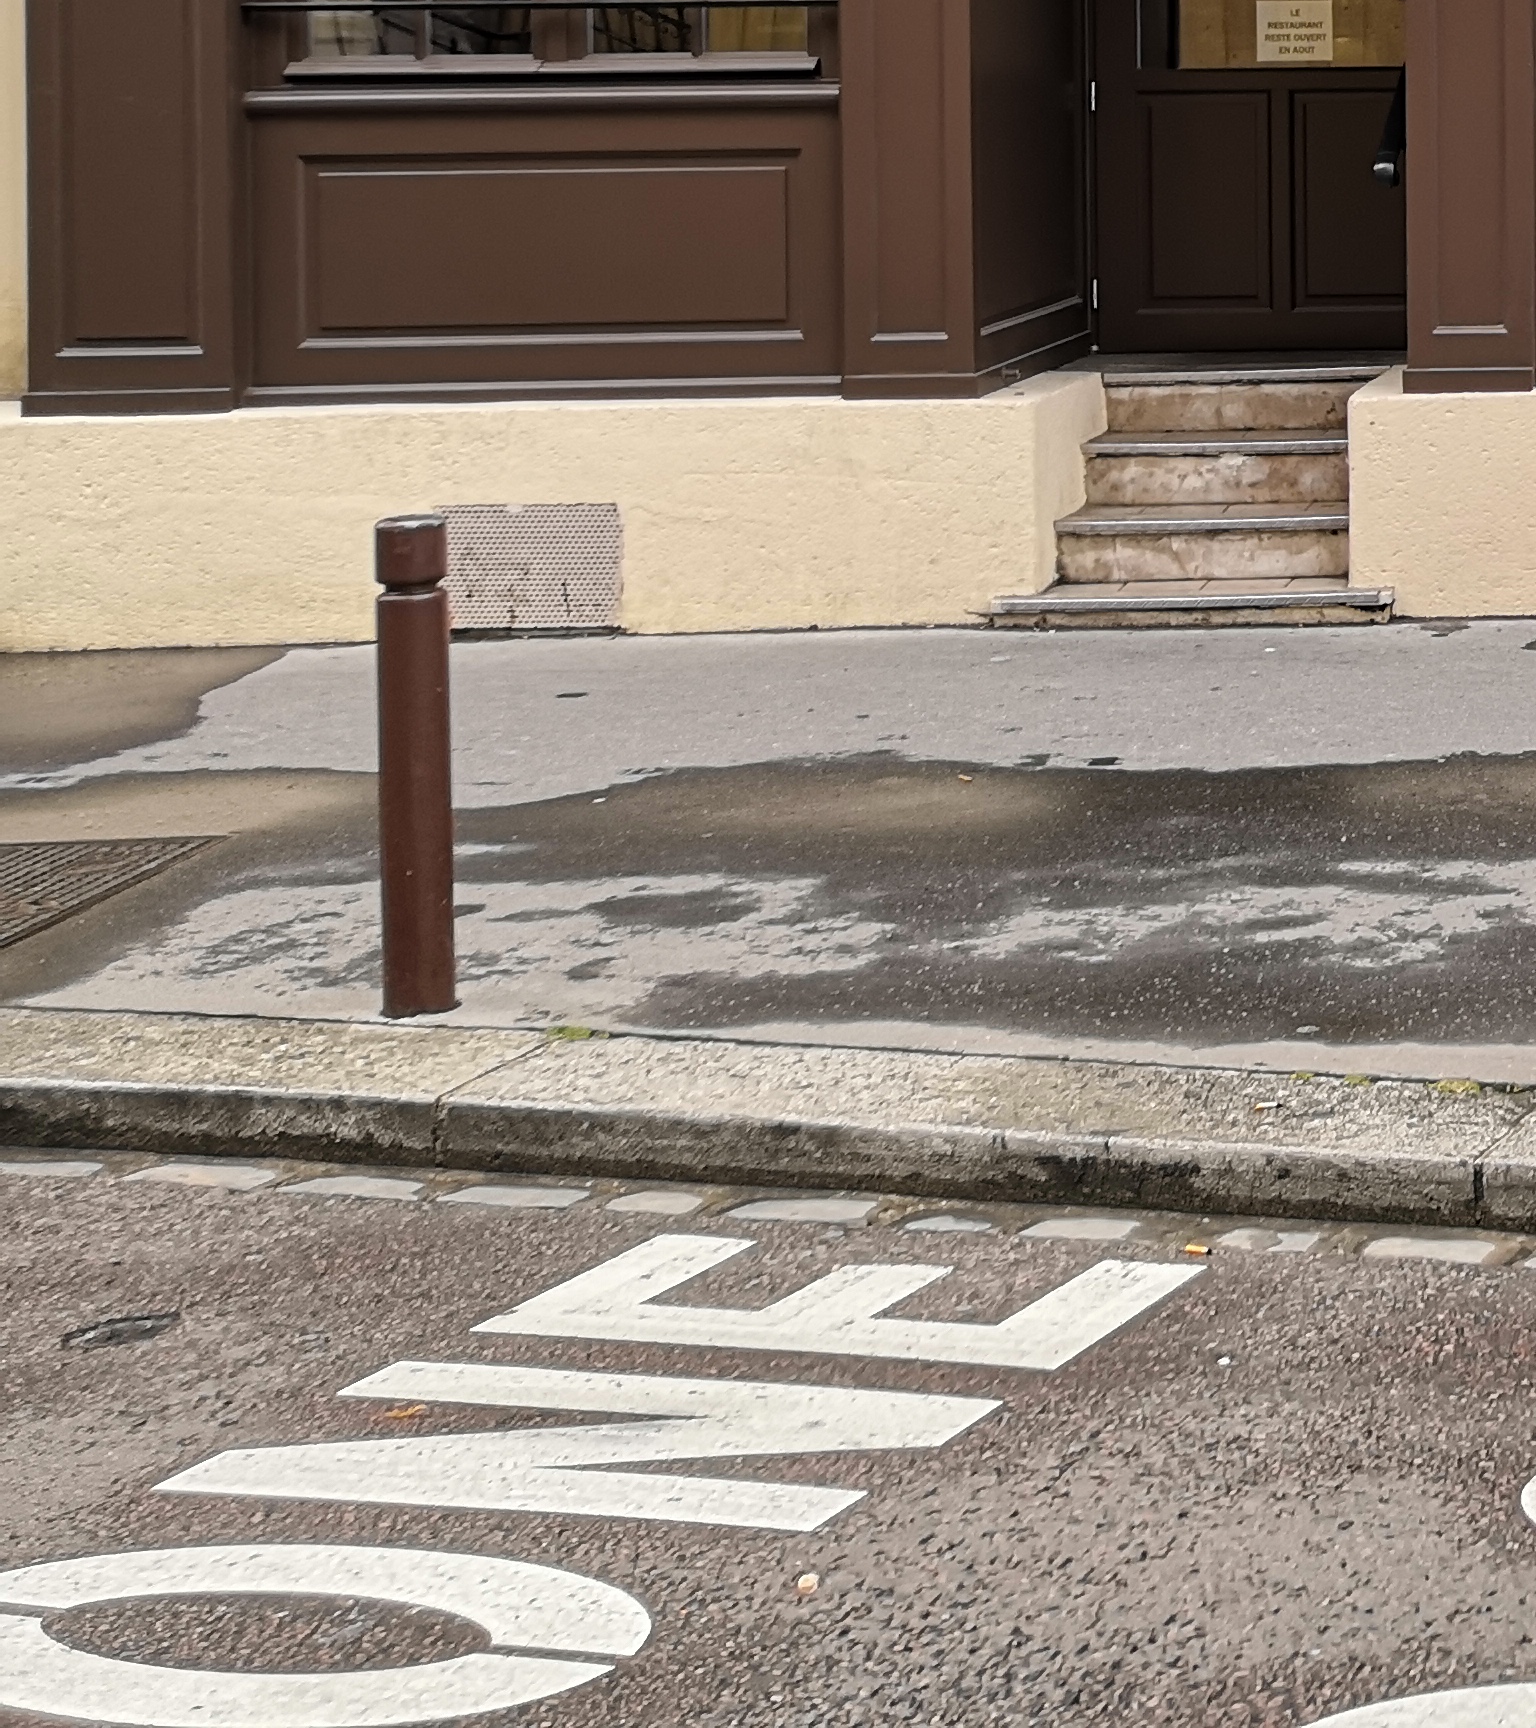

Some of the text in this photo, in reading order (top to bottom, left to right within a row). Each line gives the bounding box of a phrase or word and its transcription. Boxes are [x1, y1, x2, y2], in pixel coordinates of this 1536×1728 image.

[1290, 8, 1301, 17] LE
[1267, 21, 1324, 29] RESTAURANT
[1264, 33, 1327, 42] RESTE OUVERT
[1278, 46, 1315, 54] EN AOUT
